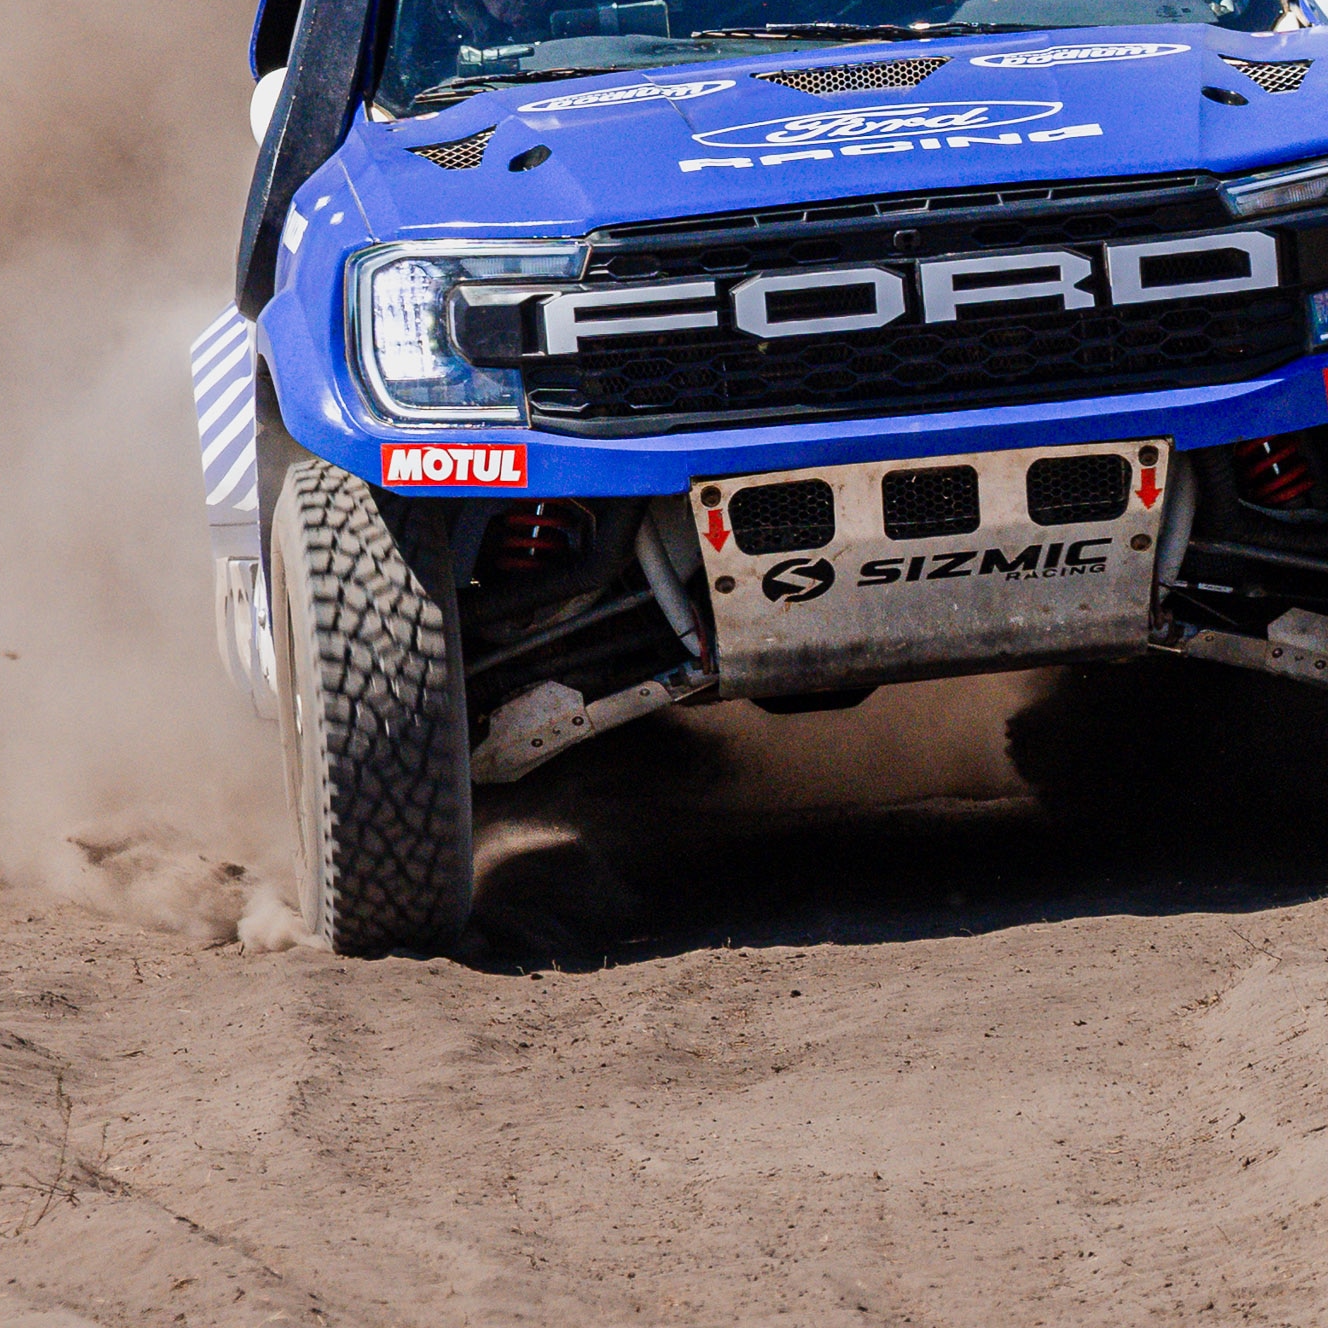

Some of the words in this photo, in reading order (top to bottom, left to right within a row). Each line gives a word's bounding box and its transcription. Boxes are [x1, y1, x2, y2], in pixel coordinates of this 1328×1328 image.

[766, 107, 989, 143] Ford
[678, 124, 1104, 172] RACING
[543, 231, 1279, 355] FORD
[387, 447, 521, 482] MOTUL
[857, 538, 1112, 587] SIZMIC
[1005, 564, 1106, 581] RACING
